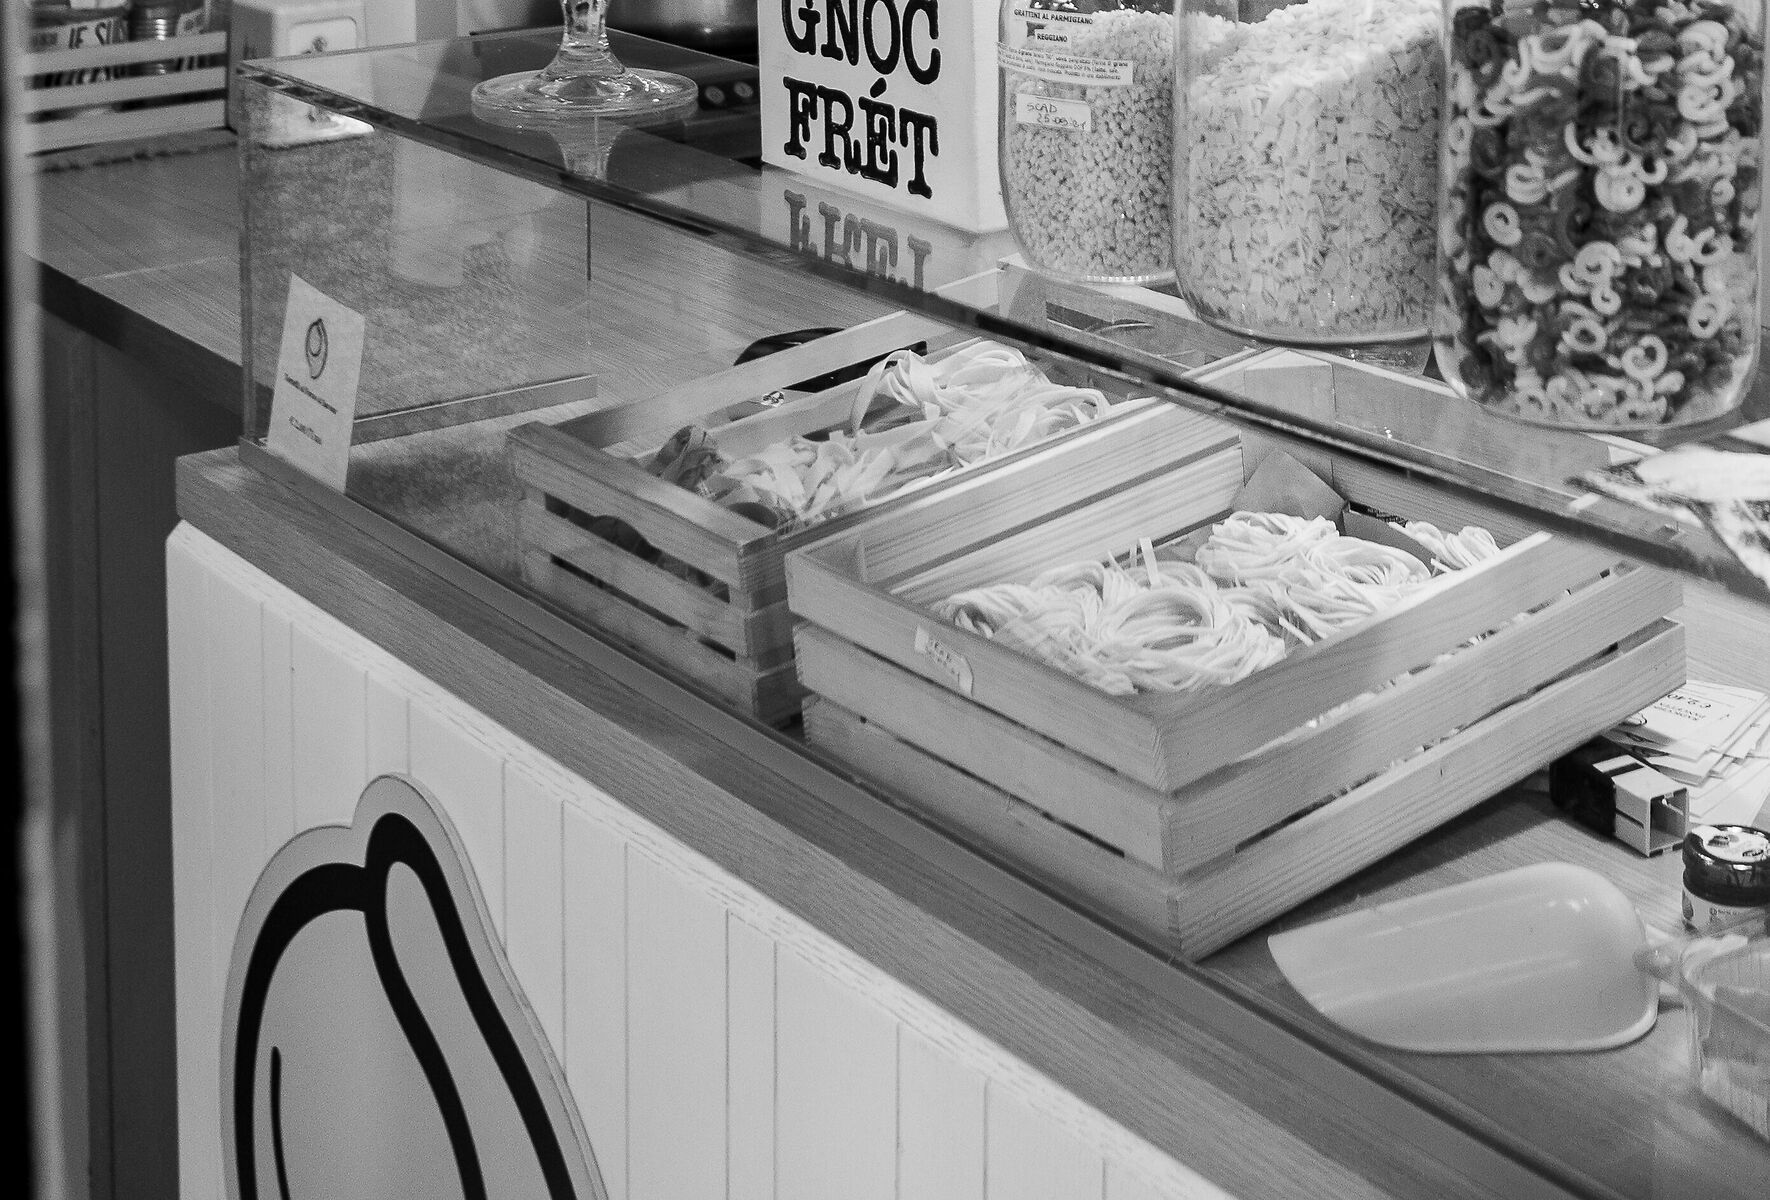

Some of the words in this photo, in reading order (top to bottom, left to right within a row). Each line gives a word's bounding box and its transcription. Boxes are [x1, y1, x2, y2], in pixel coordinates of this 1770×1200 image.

[1014, 8, 1041, 19] GRATTINI
[1051, 13, 1093, 25] PARMIGIANO
[1037, 33, 1068, 43] REGGIANO
[1027, 103, 1057, 114] SCAD
[782, 76, 939, 200] FRÉT
